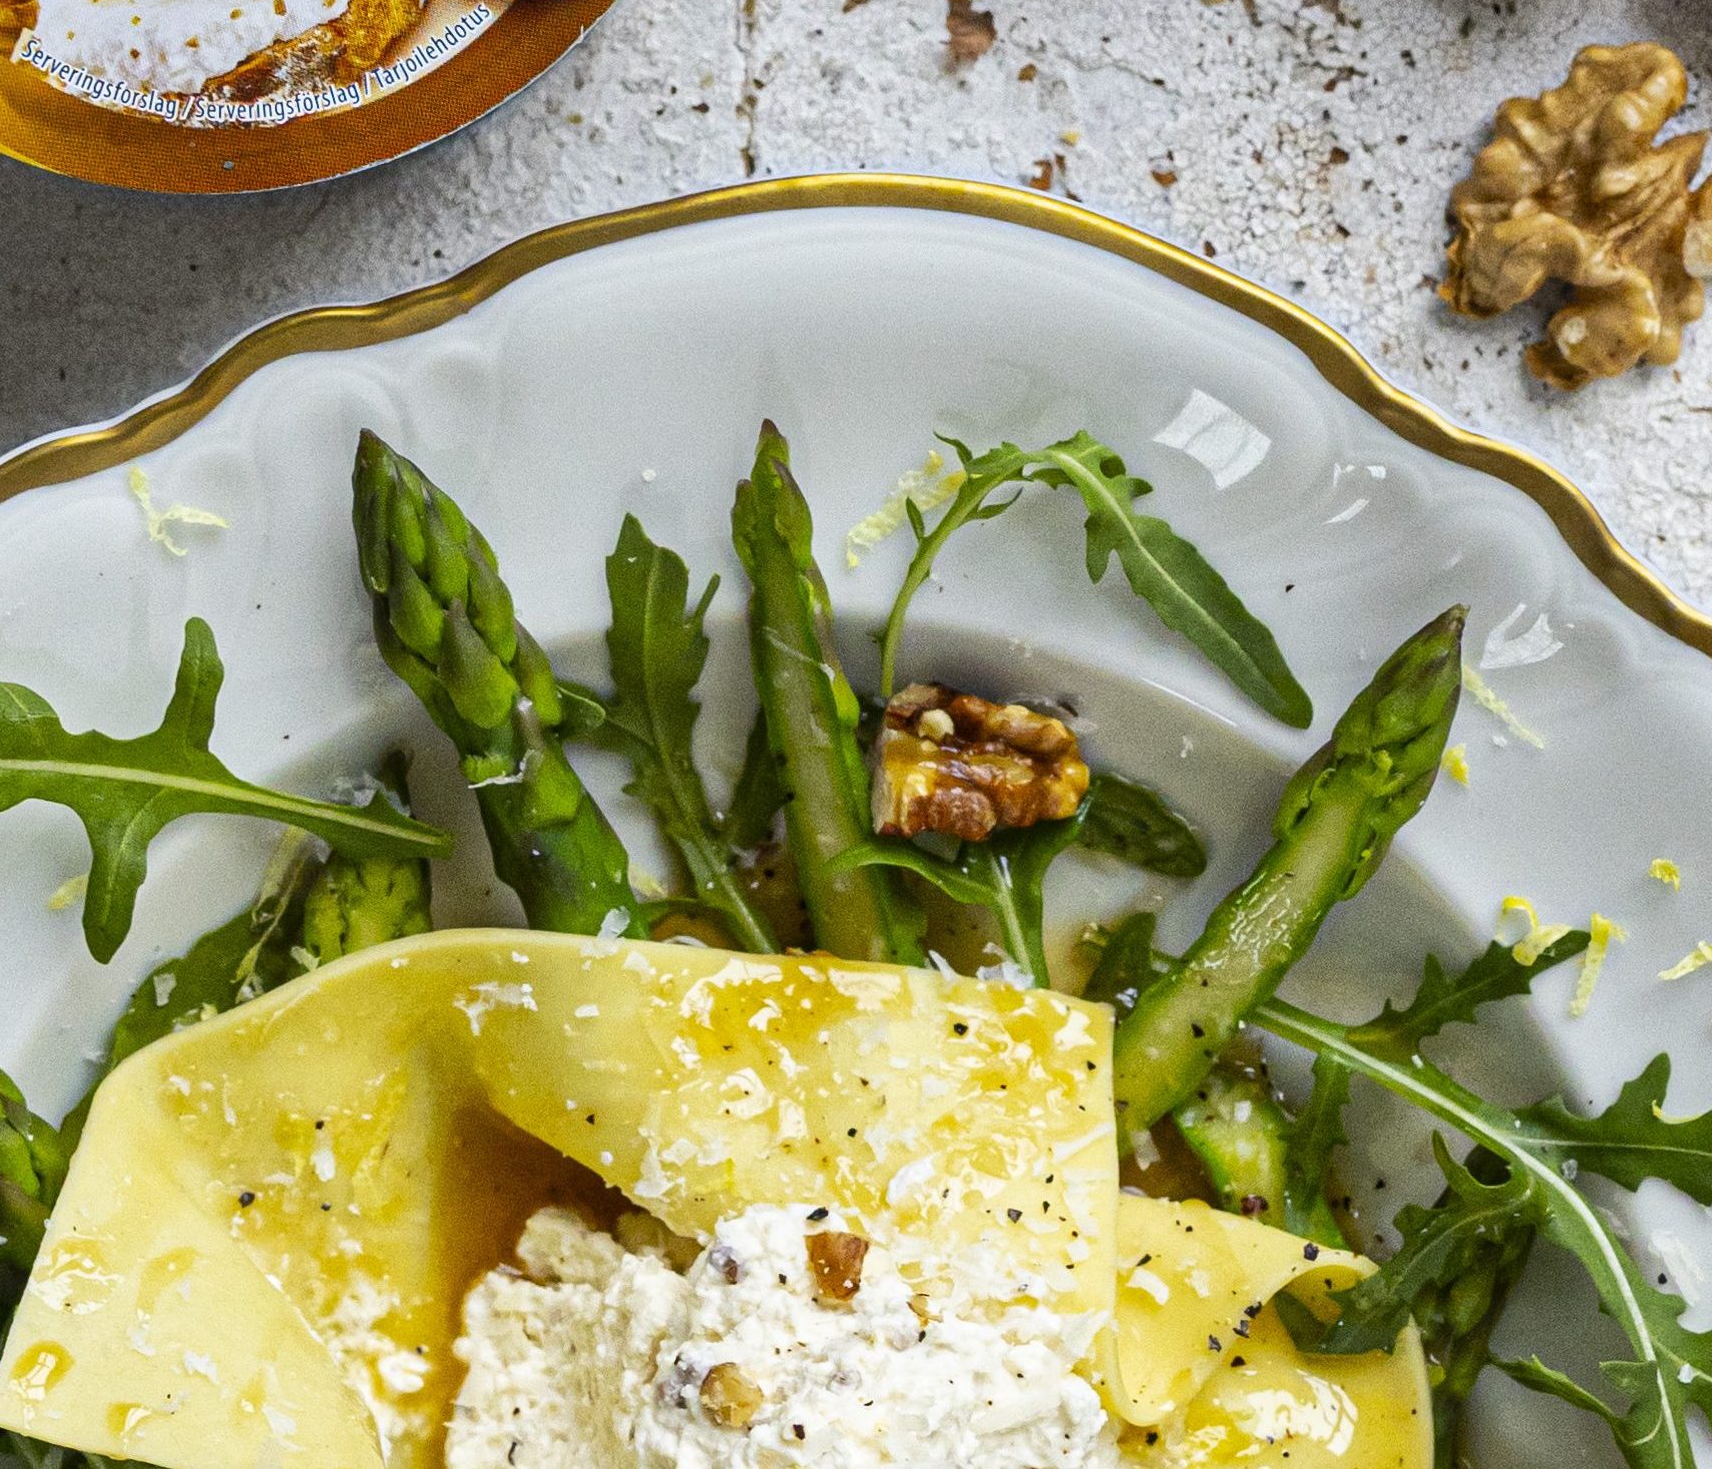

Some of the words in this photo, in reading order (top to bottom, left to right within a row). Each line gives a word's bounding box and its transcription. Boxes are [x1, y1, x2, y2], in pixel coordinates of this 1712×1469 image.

[21, 39, 177, 118] Serveringsforslag
[196, 84, 360, 121] Serveringsförslag
[372, 3, 491, 87] Tarjoilehdotus
